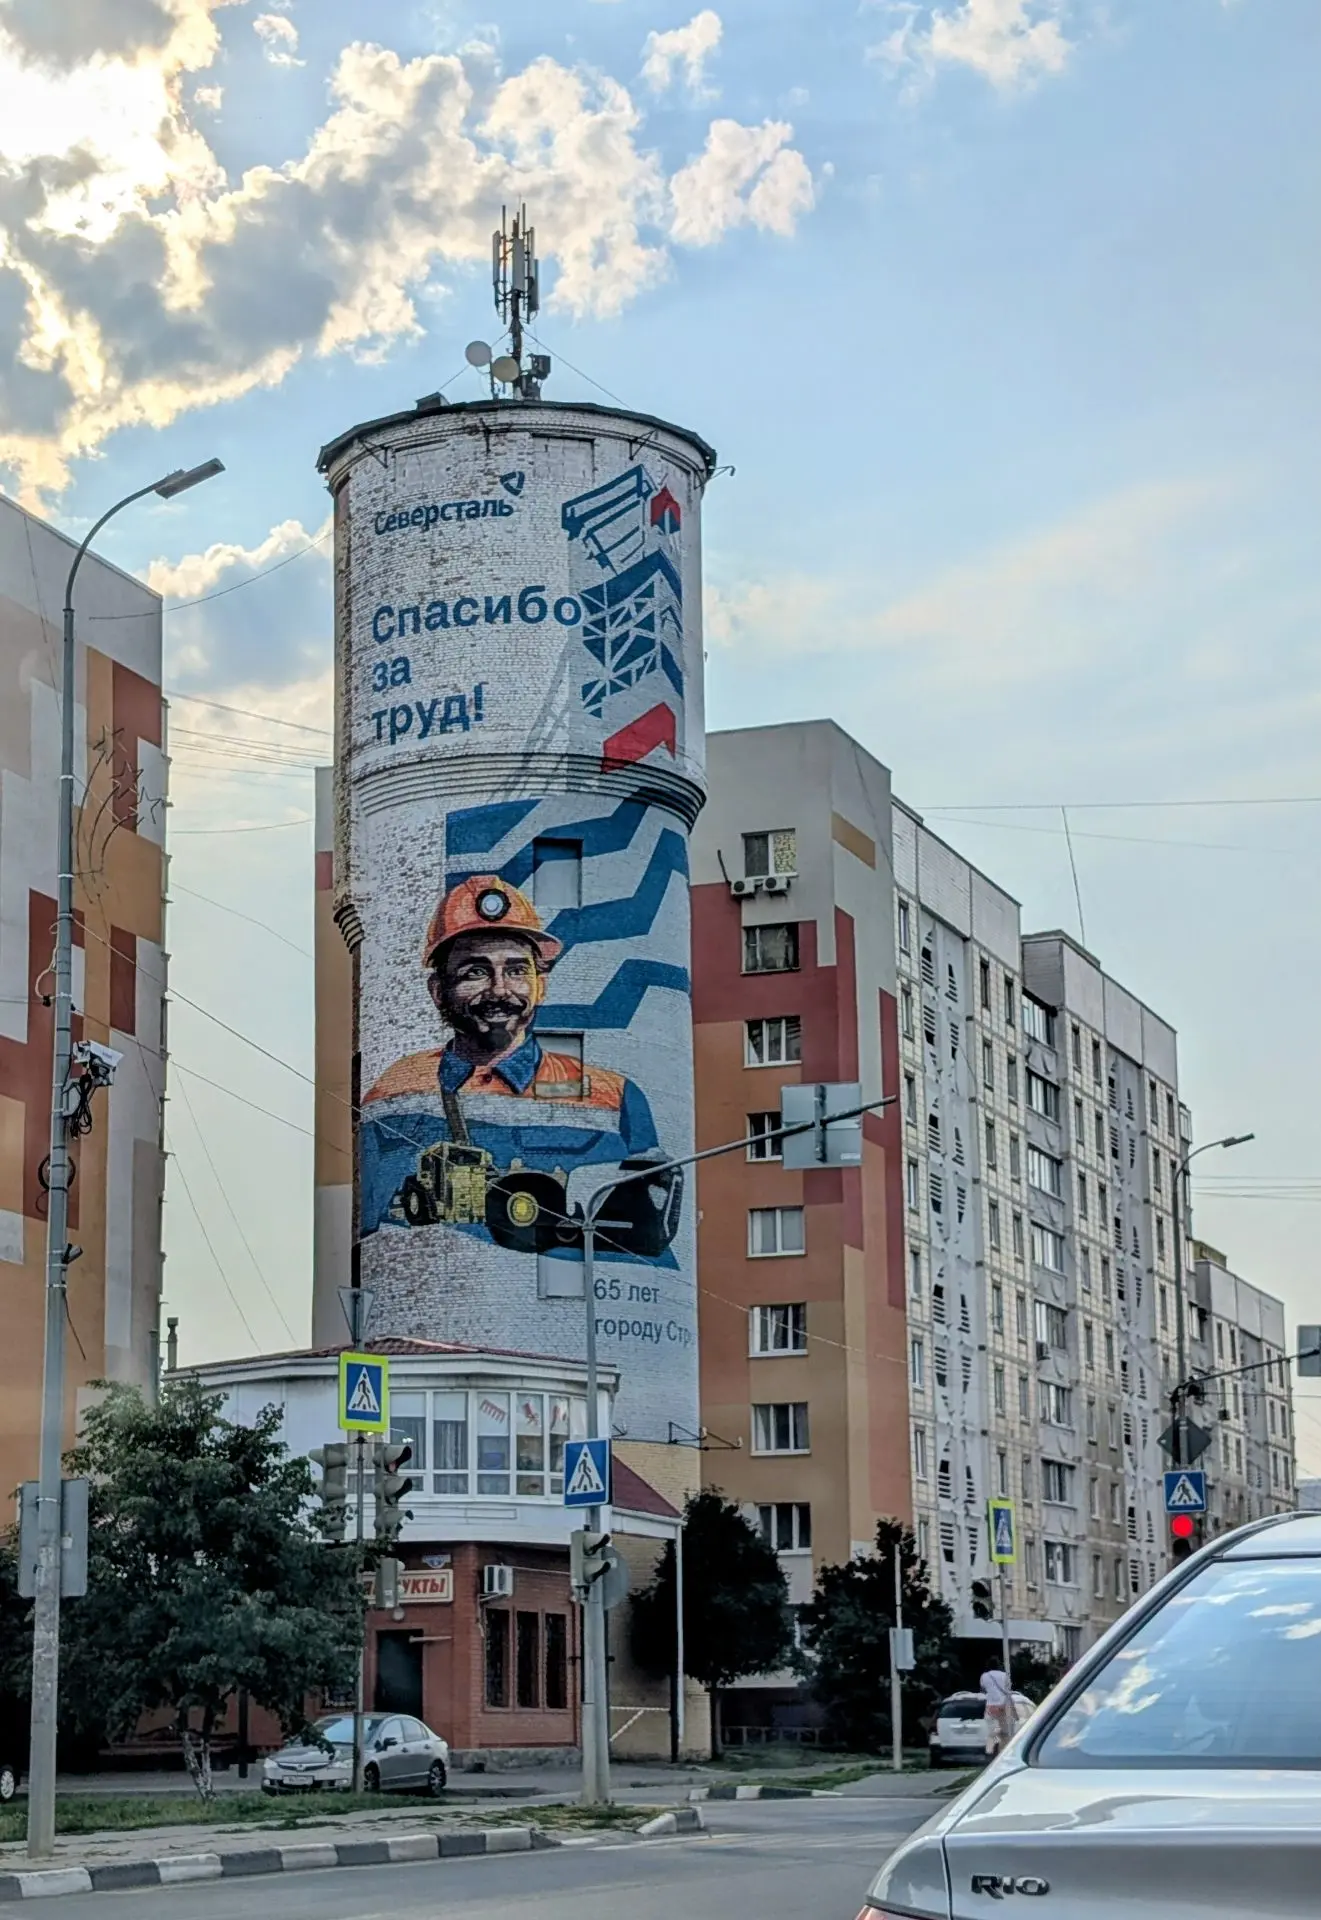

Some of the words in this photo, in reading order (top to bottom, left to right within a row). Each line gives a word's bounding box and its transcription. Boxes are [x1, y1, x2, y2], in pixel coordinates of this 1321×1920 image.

[374, 499, 514, 536] Северсталь
[372, 585, 583, 645] Спасибо
[372, 656, 412, 692] за
[371, 684, 484, 746] труд!
[594, 1278, 621, 1300] 65
[628, 1284, 660, 1304] лет
[594, 1318, 662, 1345] городу
[666, 1319, 694, 1349] Стр
[971, 1874, 1050, 1900] RIO
